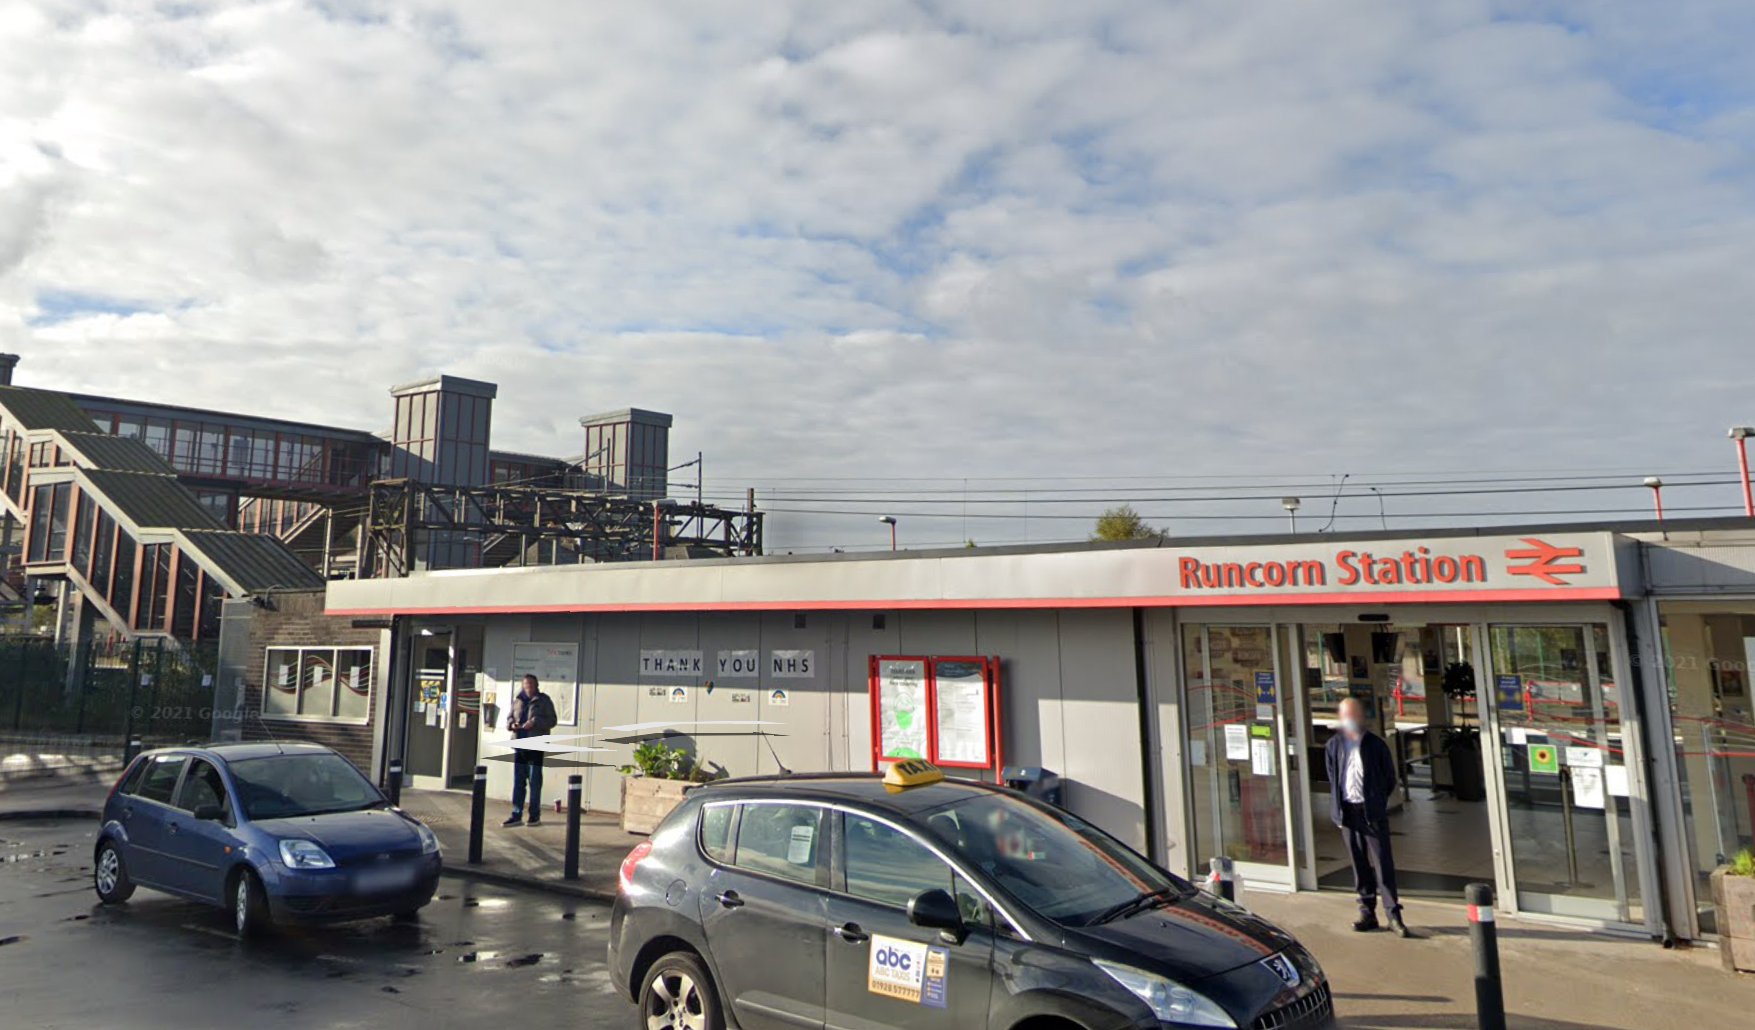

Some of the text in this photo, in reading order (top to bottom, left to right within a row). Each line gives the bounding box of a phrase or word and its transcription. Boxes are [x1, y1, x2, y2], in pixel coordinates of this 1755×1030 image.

[1179, 546, 1486, 589] Runcorn Station
[643, 657, 809, 673] THANK YOU NHS
[898, 759, 934, 775] TAXI
[876, 946, 911, 971] abc
[871, 980, 892, 992] 01928
